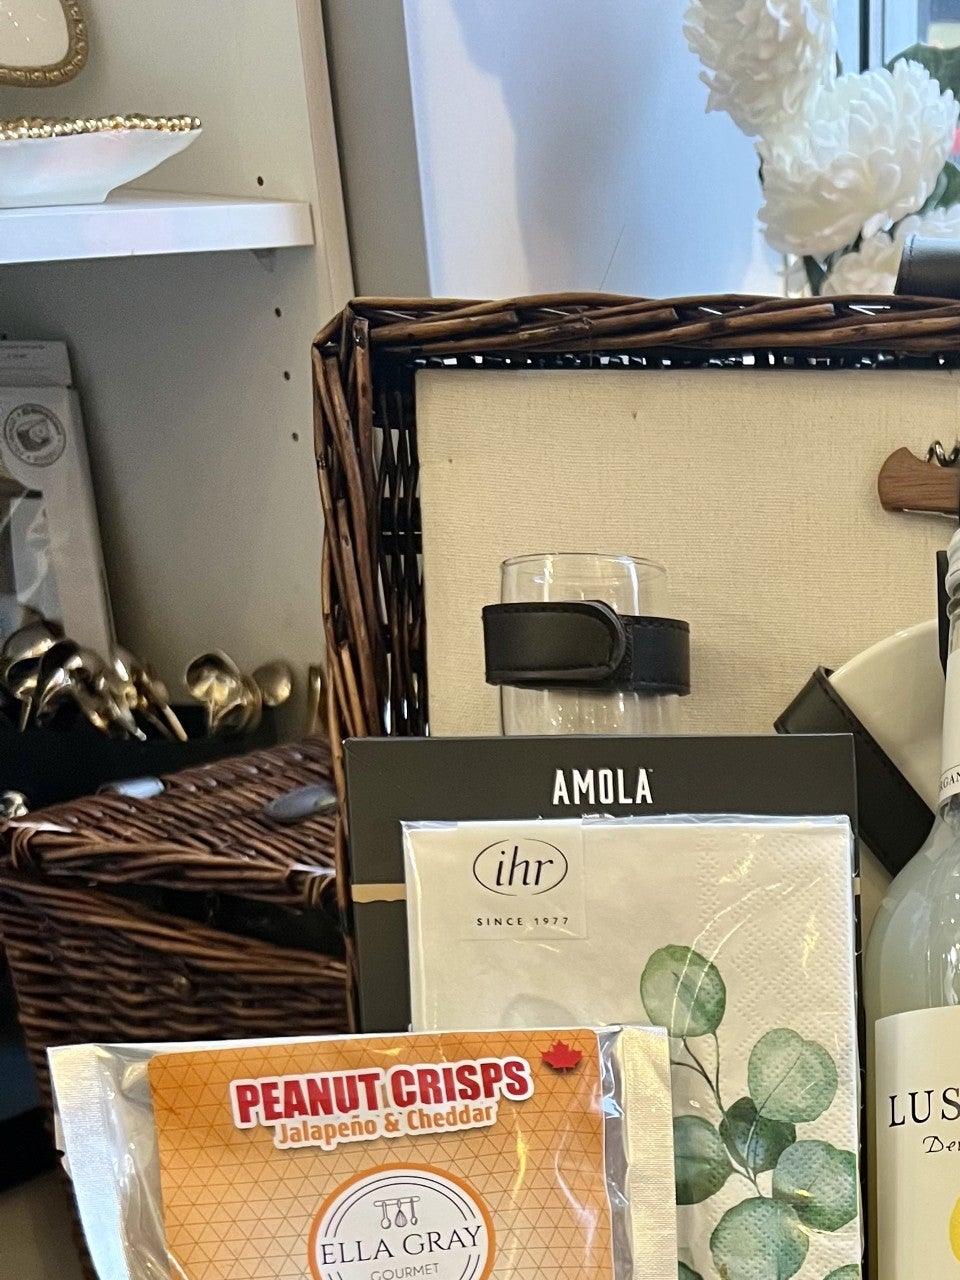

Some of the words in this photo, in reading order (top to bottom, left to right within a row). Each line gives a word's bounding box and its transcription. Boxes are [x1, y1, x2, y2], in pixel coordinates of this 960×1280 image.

[552, 767, 653, 805] AMOLA
[496, 845, 554, 887] ihr
[476, 917, 523, 926] SINCE
[534, 917, 569, 926] 1977
[235, 1073, 381, 1123] PEANUT
[390, 1060, 530, 1108] CRISPS
[279, 1114, 377, 1145] Jalapeño
[384, 1112, 401, 1132] &
[406, 1104, 494, 1131] Cheddar
[320, 1243, 395, 1266] ELLA
[402, 1225, 483, 1256] GRAY
